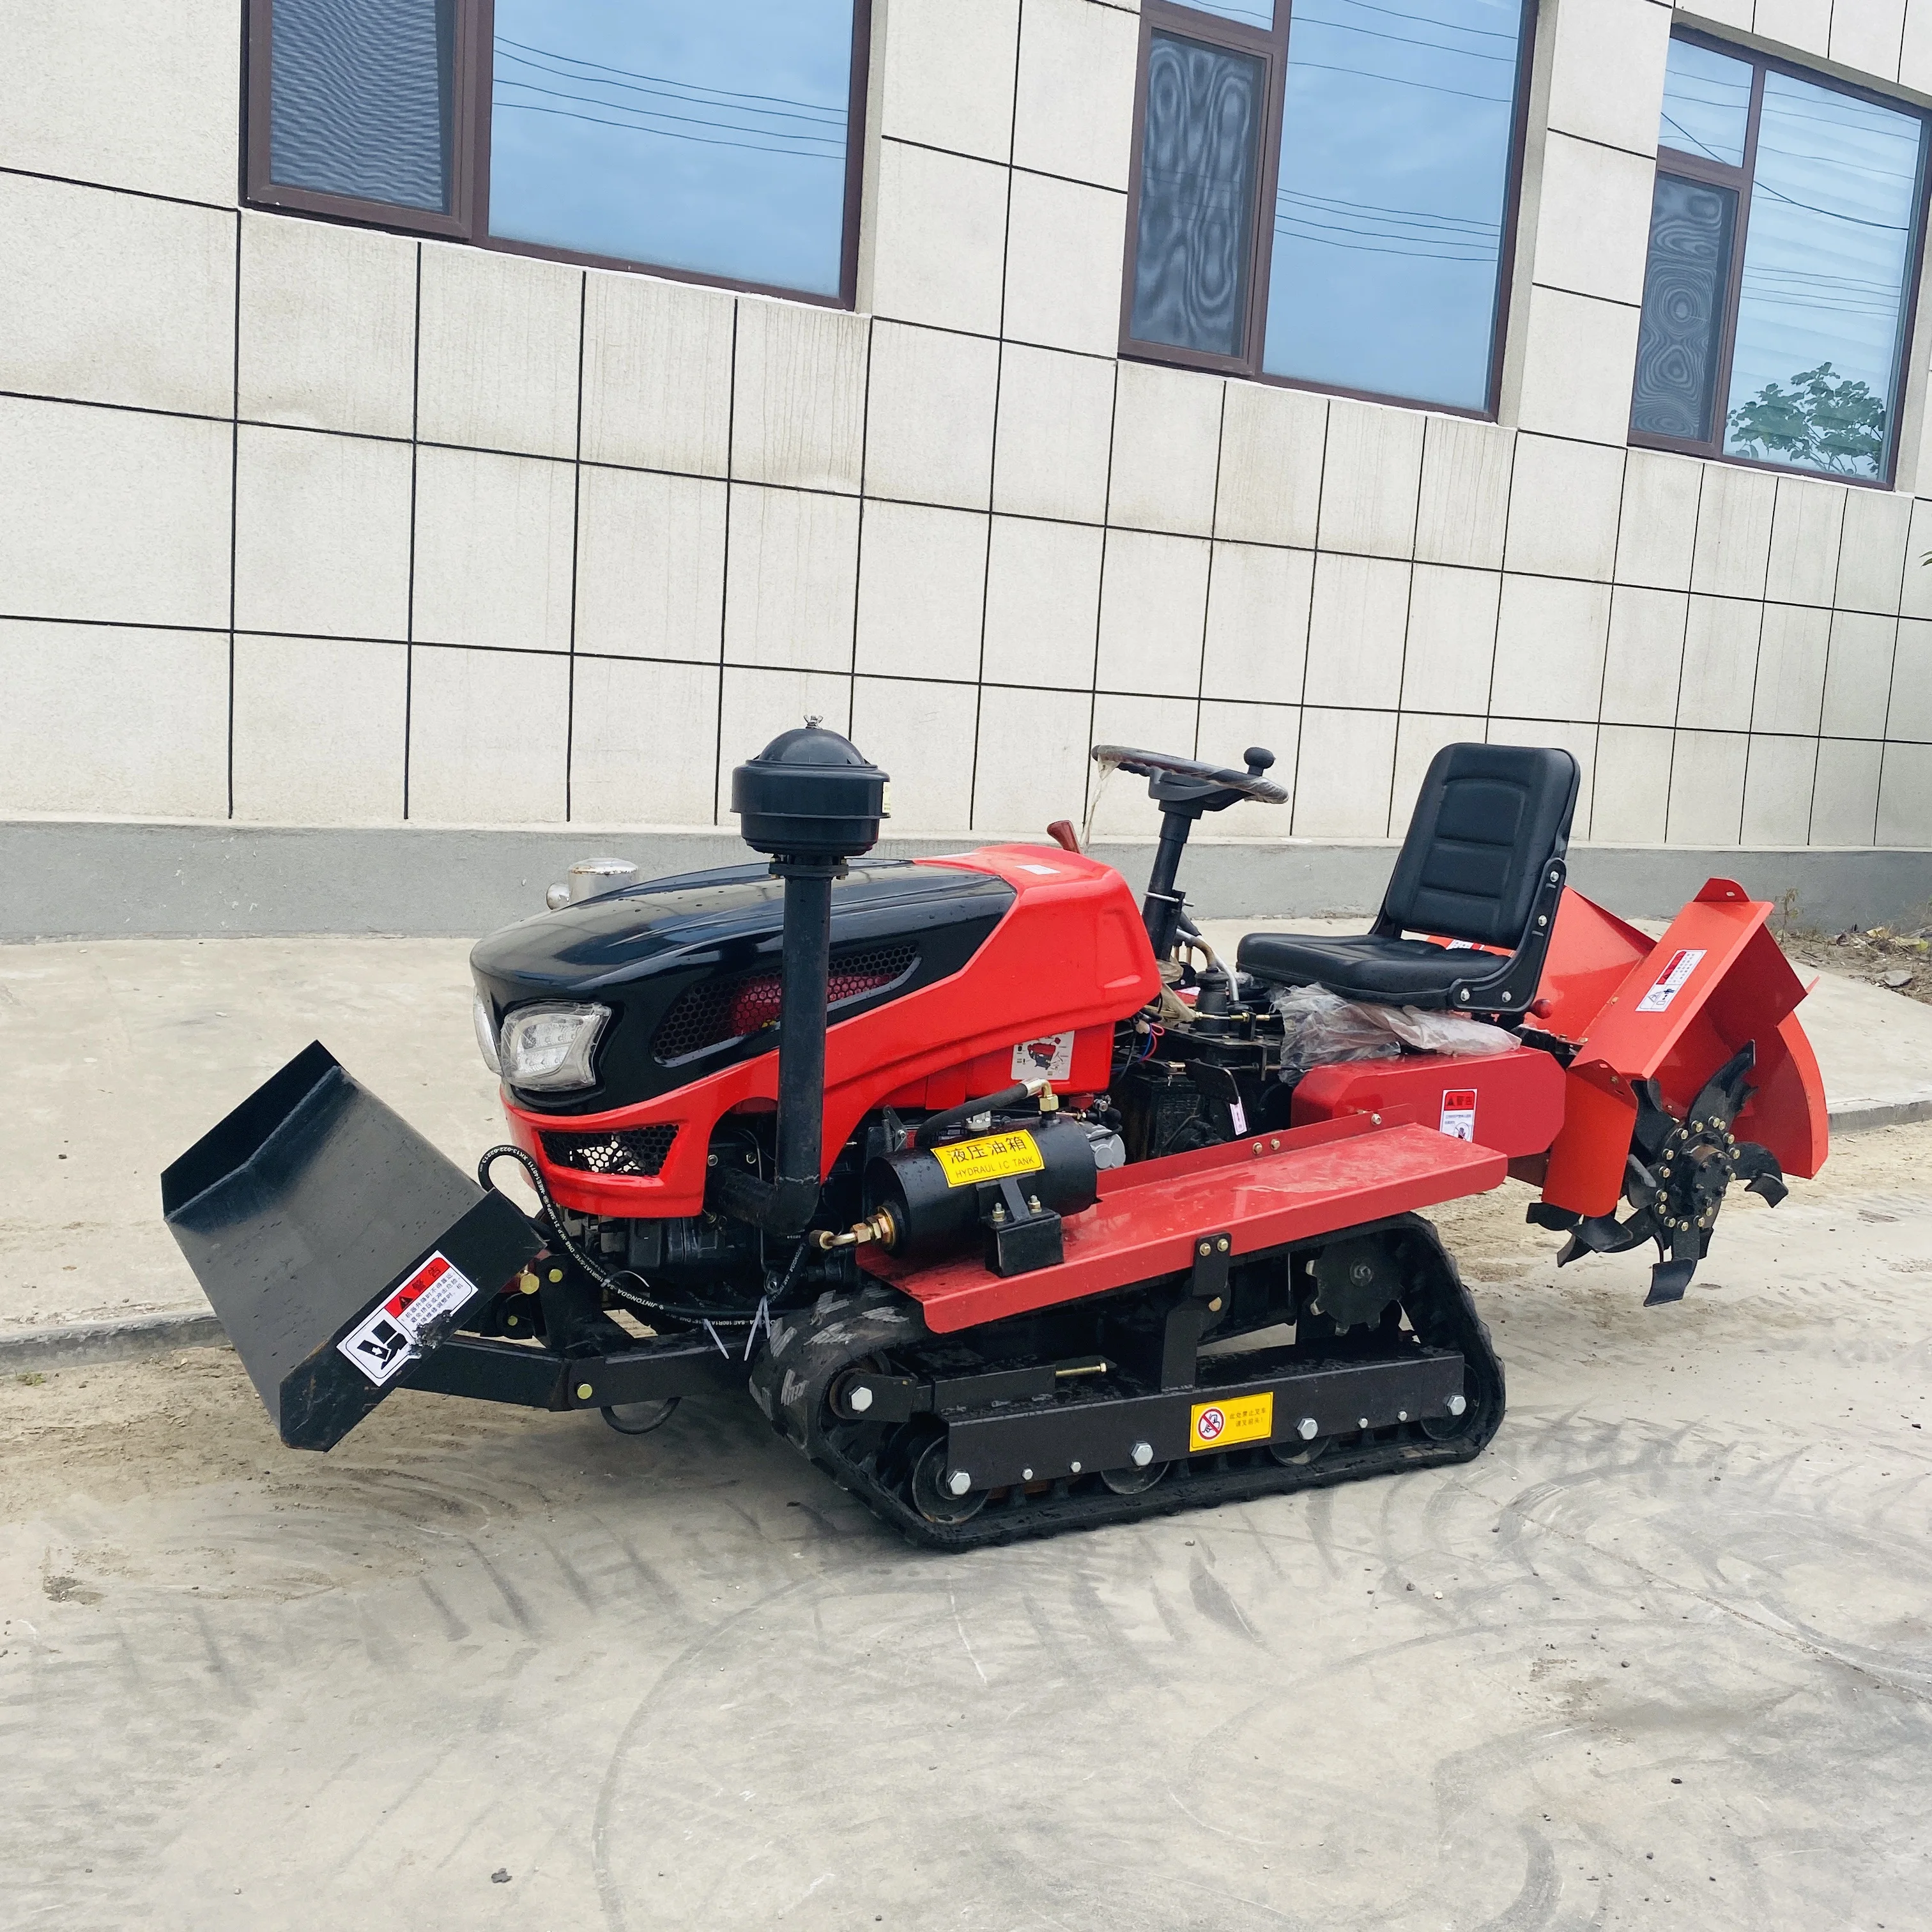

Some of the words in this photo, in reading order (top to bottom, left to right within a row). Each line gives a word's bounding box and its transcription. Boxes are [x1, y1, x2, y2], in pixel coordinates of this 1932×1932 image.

[946, 1136, 1027, 1164] 液压油箱
[1014, 1156, 1035, 1167] TANK
[411, 1266, 441, 1292] 警告
[617, 1288, 657, 1308] JINTONGDA
